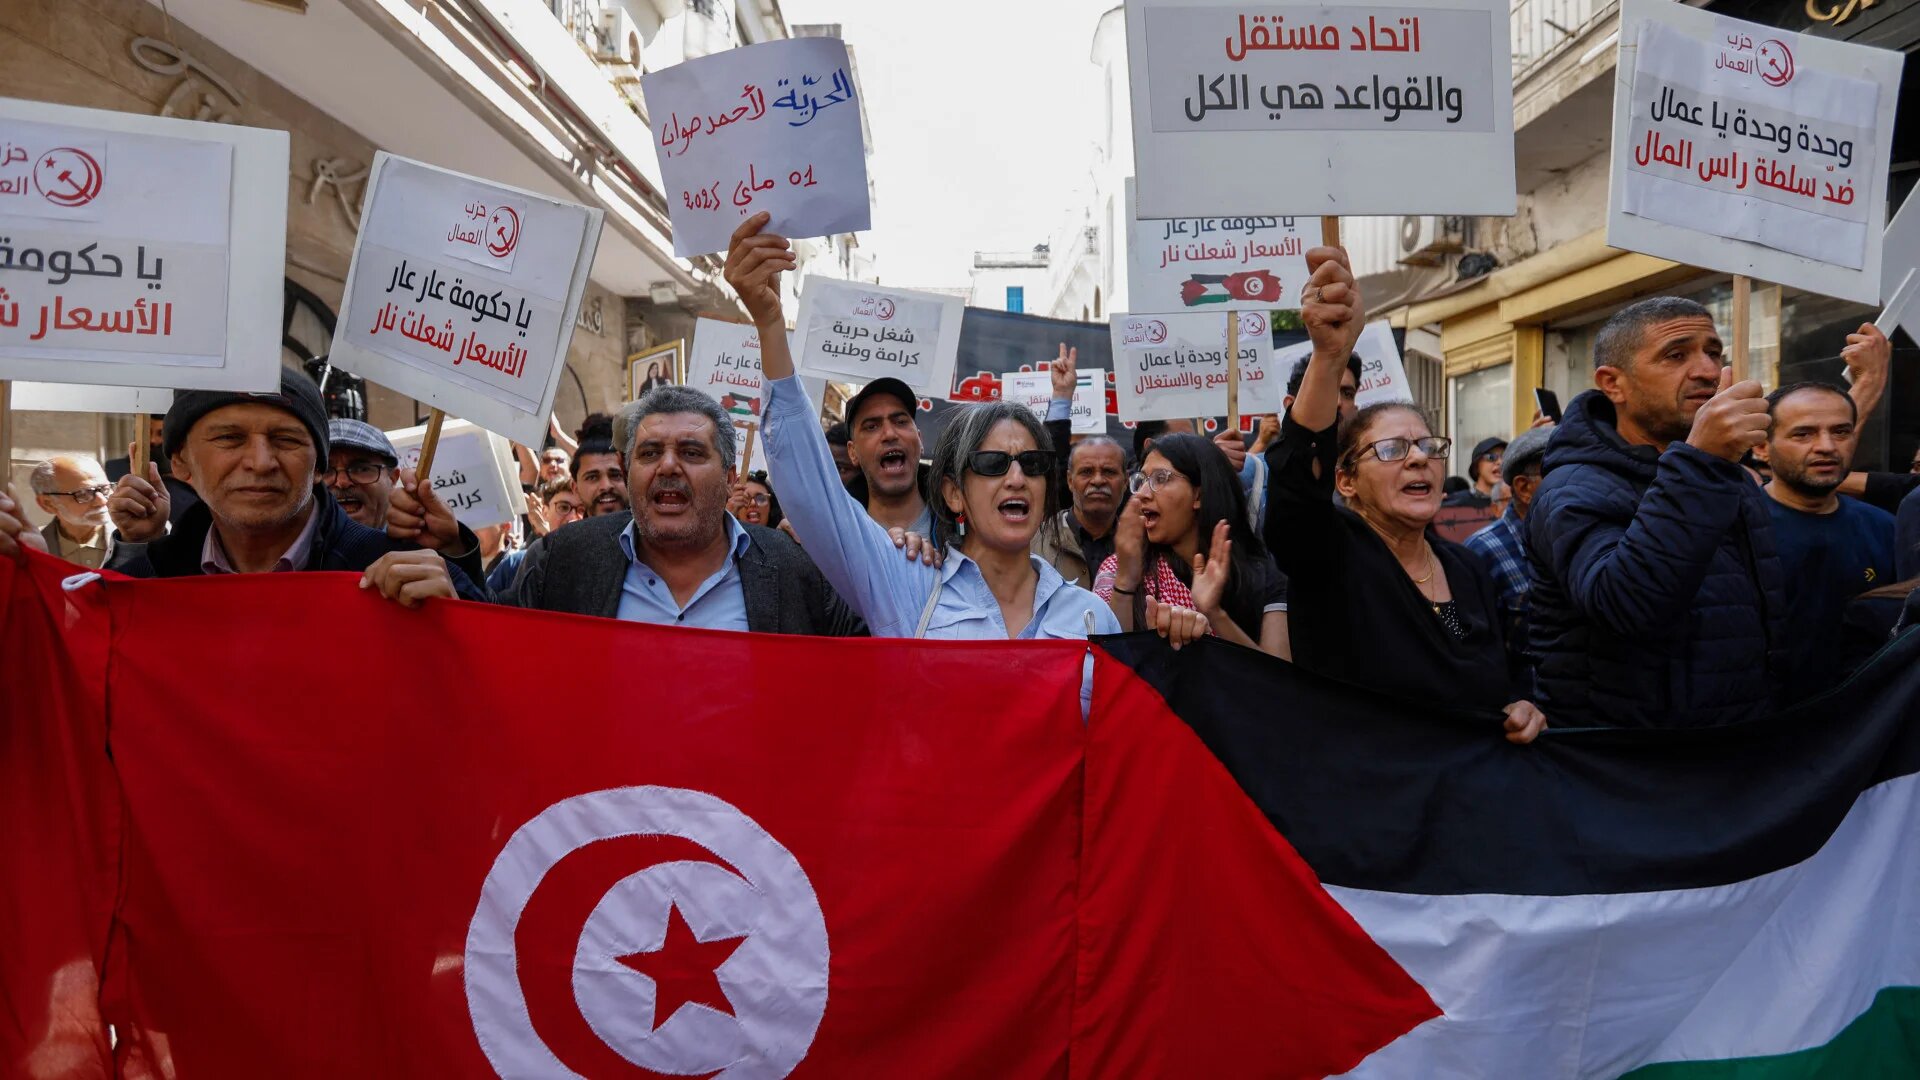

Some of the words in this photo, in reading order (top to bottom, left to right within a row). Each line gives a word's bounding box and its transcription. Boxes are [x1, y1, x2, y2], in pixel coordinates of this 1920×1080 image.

[1225, 14, 1340, 62] مستقل
[1350, 15, 1420, 52] اتحاد
[1727, 32, 1753, 51] حزب
[1715, 52, 1753, 75] العمال
[1184, 73, 1250, 122] الكل
[1260, 83, 1324, 121] هي
[1334, 74, 1463, 124] والقواعد
[1651, 86, 1704, 126] عمال
[1711, 101, 1728, 139] يا
[1733, 108, 1792, 153] وحدة
[661, 112, 702, 158] صواب
[1797, 123, 1853, 168] وحدة
[0, 141, 29, 167] حز
[1635, 130, 1692, 169] المال
[788, 164, 818, 187] 01
[1698, 152, 1748, 189] راس
[1754, 157, 1816, 198] سلطة
[733, 163, 775, 215] ماي
[464, 201, 487, 221] حزب
[447, 223, 483, 246] العمال
[1163, 218, 1188, 240] عار
[1192, 217, 1217, 238] عار
[1160, 244, 1180, 269] نار
[1184, 238, 1236, 261] شعلت
[1241, 236, 1302, 264] الأسعار
[137, 246, 163, 290] يا
[386, 260, 416, 293] عار
[416, 269, 446, 303] عار
[450, 277, 511, 323] حكومة
[30, 295, 173, 341] الأسعار
[370, 302, 399, 335] نار
[400, 310, 455, 353] شعلت
[515, 298, 532, 338] يا
[832, 320, 869, 340] حرية
[873, 326, 914, 344] شغل
[453, 331, 528, 379] الأسعار
[715, 352, 732, 367] عار
[734, 354, 751, 370] عار
[822, 340, 871, 362] وطنية
[875, 347, 920, 368] كرامة
[1139, 352, 1172, 371] عمال
[1175, 348, 1185, 368] يا
[1188, 348, 1221, 366] وحدة
[708, 370, 724, 385] نار
[1362, 359, 1383, 372] وحد
[726, 372, 760, 389] شعلت
[1135, 371, 1202, 394] والاستغلال
[433, 469, 467, 490] شغ
